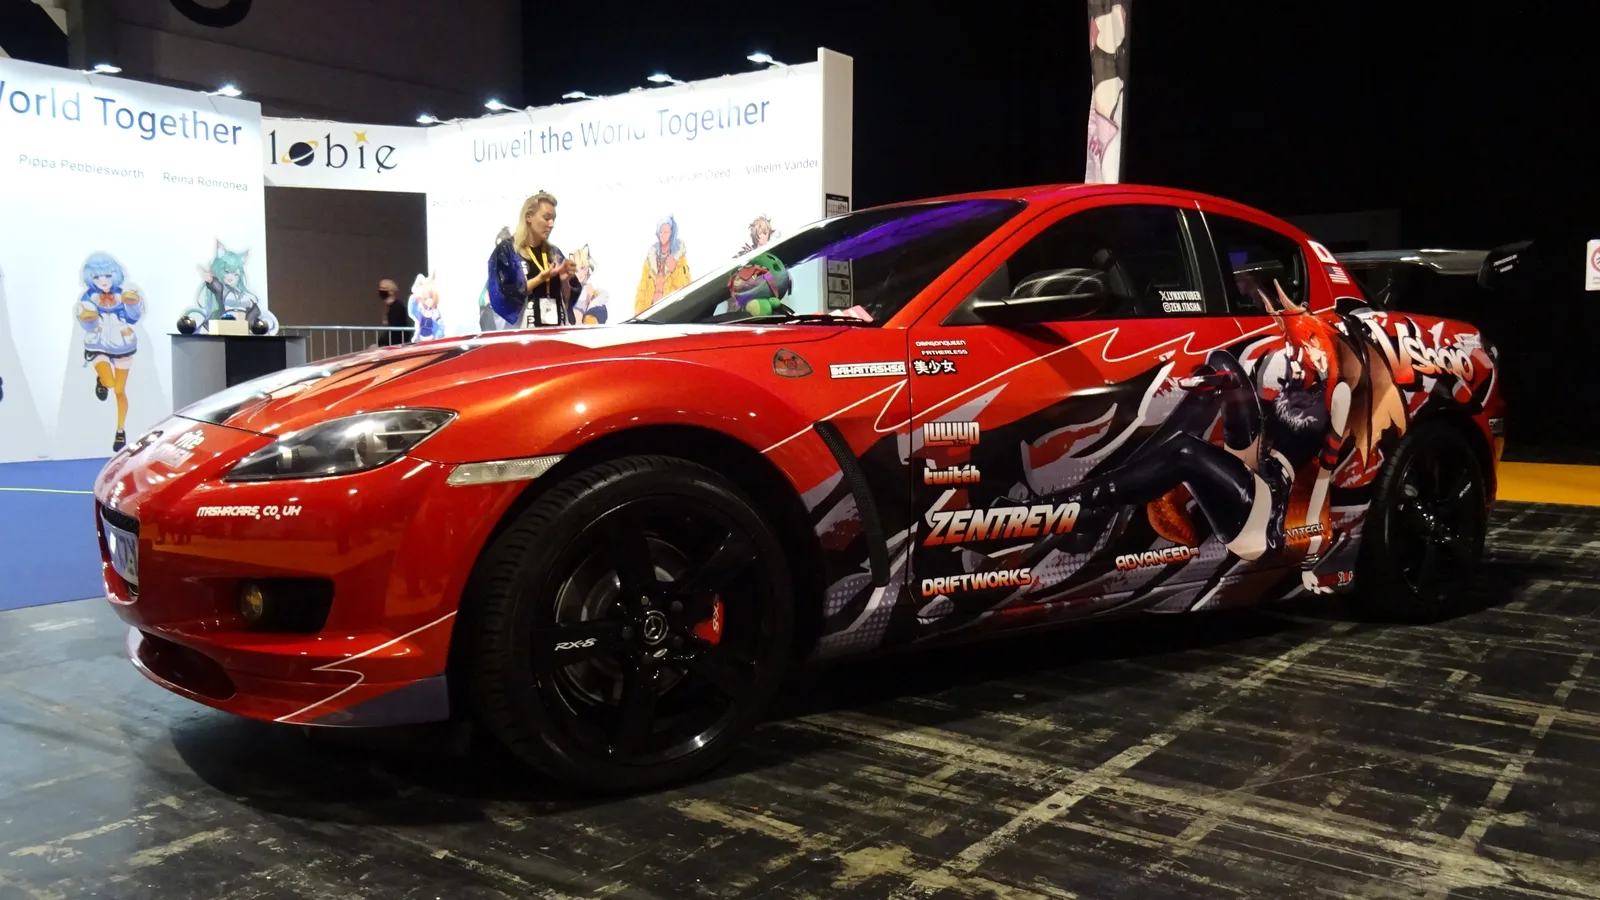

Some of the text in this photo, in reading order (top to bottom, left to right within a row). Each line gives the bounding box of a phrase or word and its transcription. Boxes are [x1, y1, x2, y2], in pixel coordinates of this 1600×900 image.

[93, 96, 242, 145] Together
[473, 129, 532, 163] Unveil
[540, 126, 573, 154] the
[656, 97, 770, 141] Together
[19, 154, 145, 180] Pippa Pebblesworth
[745, 161, 781, 175] Vilhelm
[163, 172, 249, 192] Reina Ronronea
[913, 359, 957, 375] 美少女
[924, 464, 980, 485] twitch
[922, 502, 1081, 547] ZENTREYA
[921, 568, 1033, 597] DRIFTWORKS
[554, 637, 598, 651] RX-8
